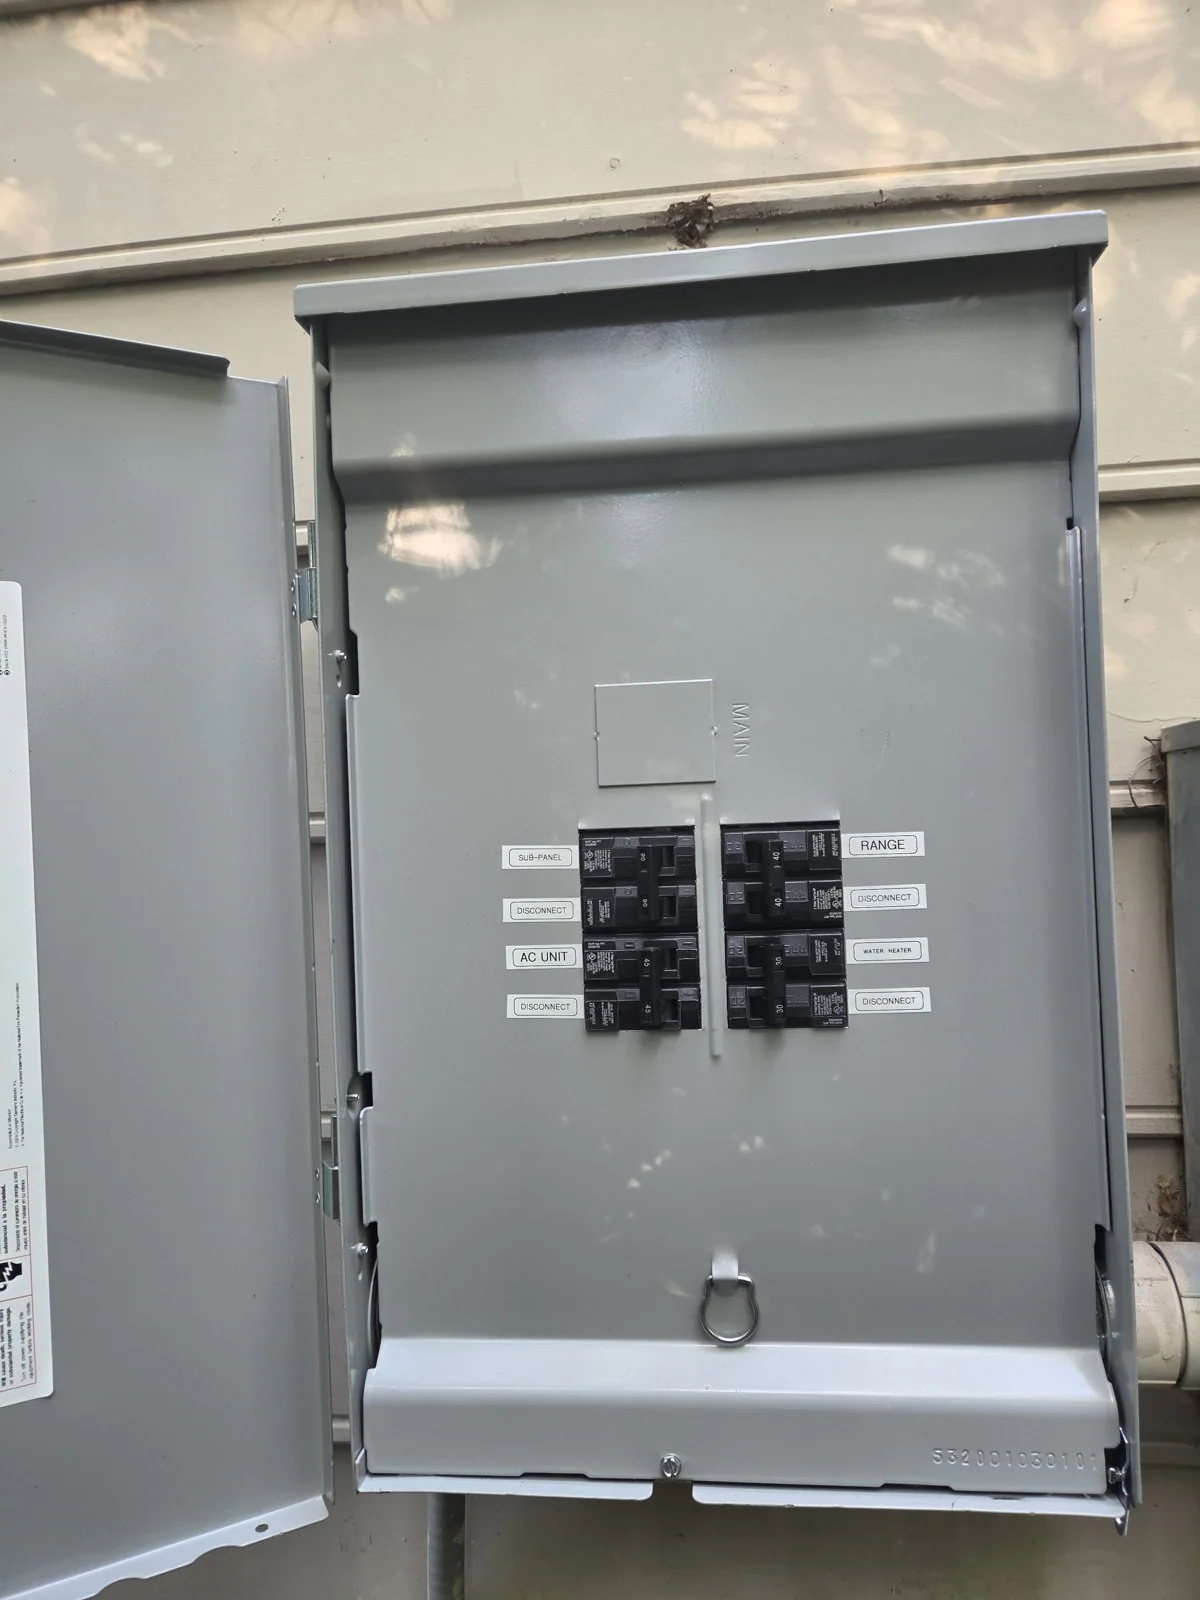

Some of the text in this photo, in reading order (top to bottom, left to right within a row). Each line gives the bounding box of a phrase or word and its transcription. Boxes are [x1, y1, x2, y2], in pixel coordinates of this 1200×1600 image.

[732, 703, 750, 757] MAIN
[860, 839, 906, 851] RANGE
[518, 853, 563, 862] SUB-PANEL
[772, 851, 781, 861] 40
[774, 897, 783, 907] 40
[857, 893, 912, 903] DISCONNECT
[517, 906, 567, 915] DISCONNECT
[520, 951, 568, 963] AC UNIT
[775, 956, 783, 966] 30
[644, 958, 650, 967] 45
[862, 996, 916, 1006] DISCONNECT
[520, 1003, 570, 1011] DISCONNECT
[645, 1004, 652, 1014] 45
[776, 1004, 784, 1014] 30
